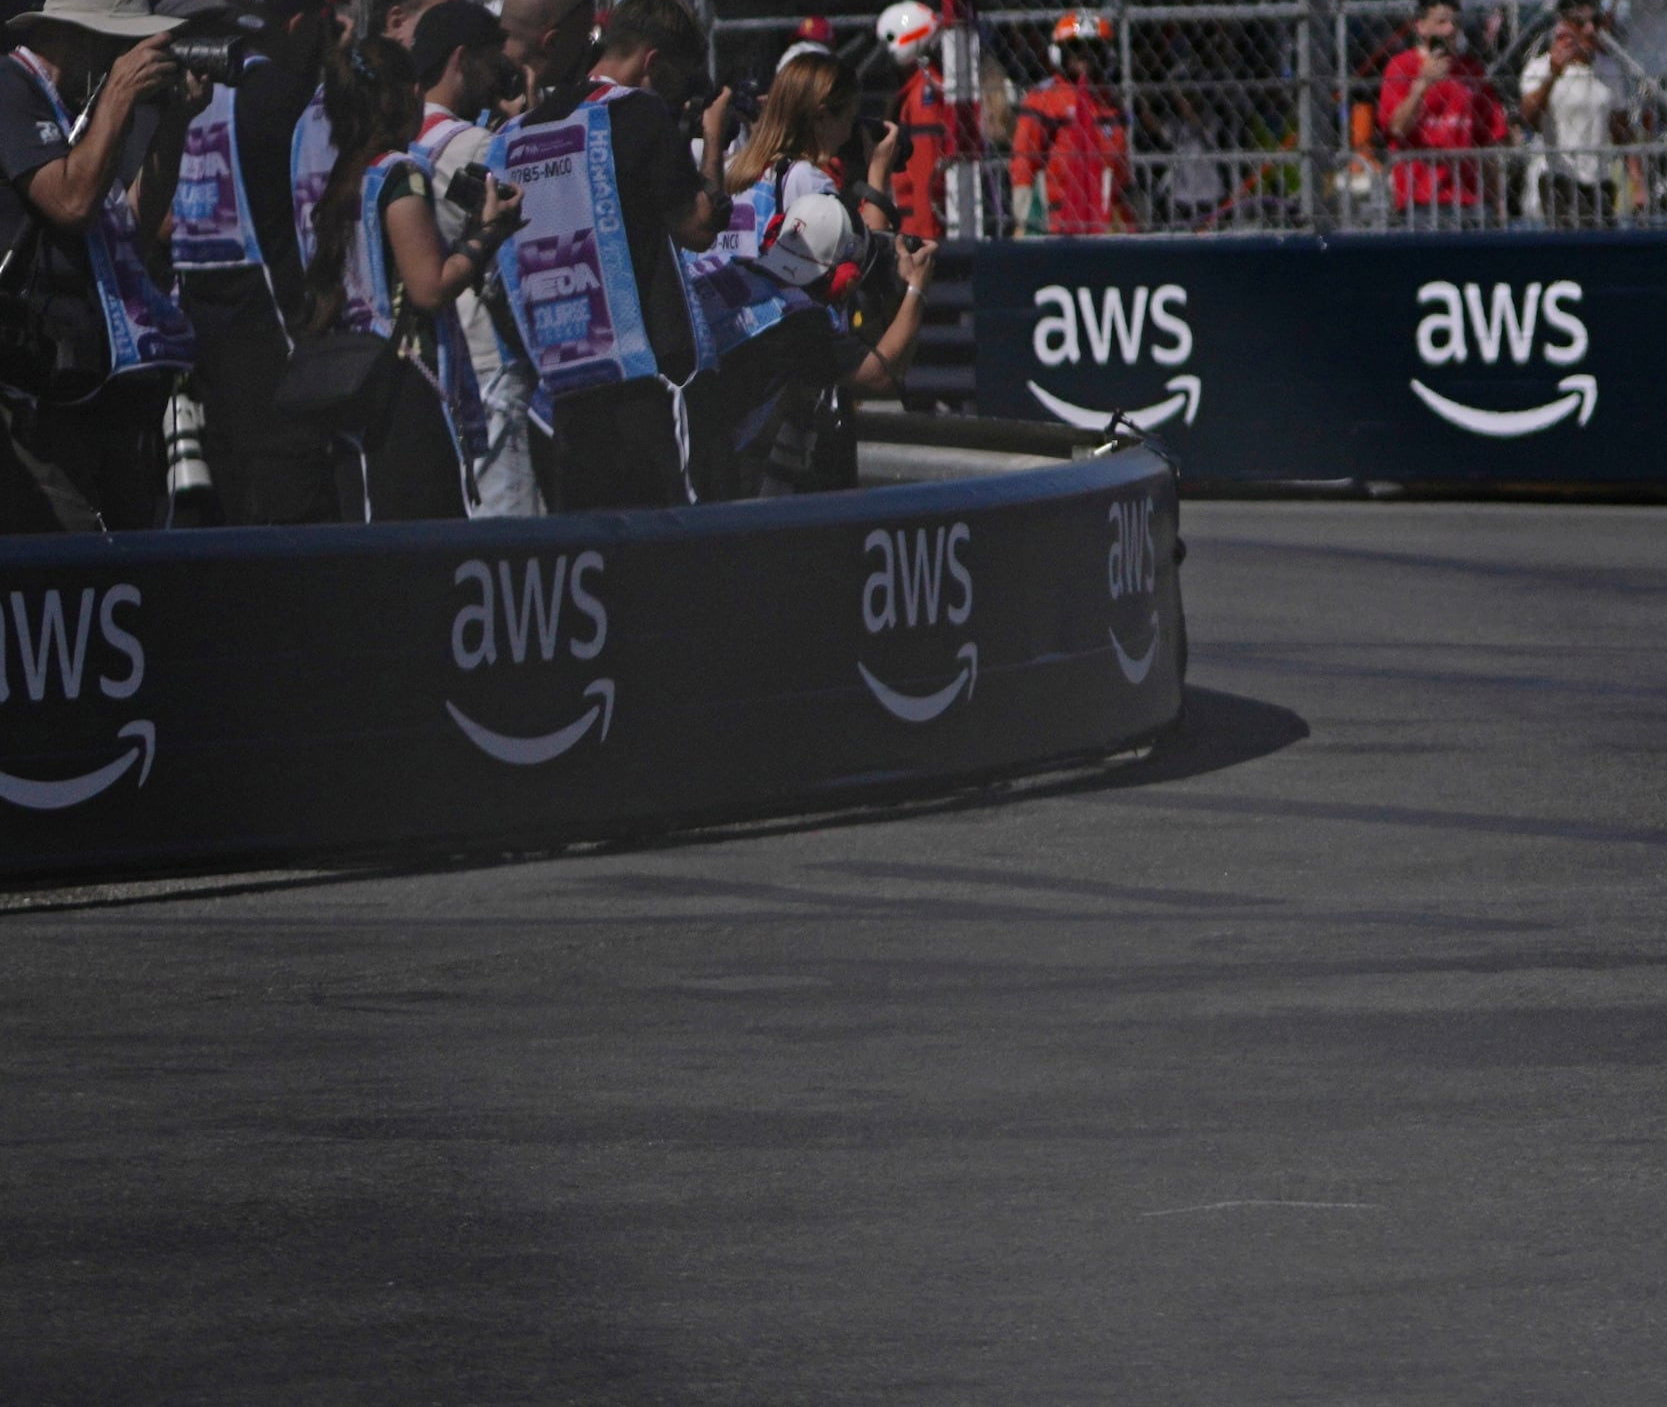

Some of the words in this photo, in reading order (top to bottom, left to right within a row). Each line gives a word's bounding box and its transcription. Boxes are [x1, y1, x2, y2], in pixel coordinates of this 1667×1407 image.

[1033, 284, 1193, 366] aws
[1416, 280, 1589, 365] aws
[863, 522, 974, 632] aws
[1108, 497, 1155, 599] aws
[0, 584, 145, 700] ws
[451, 551, 608, 671] aws
